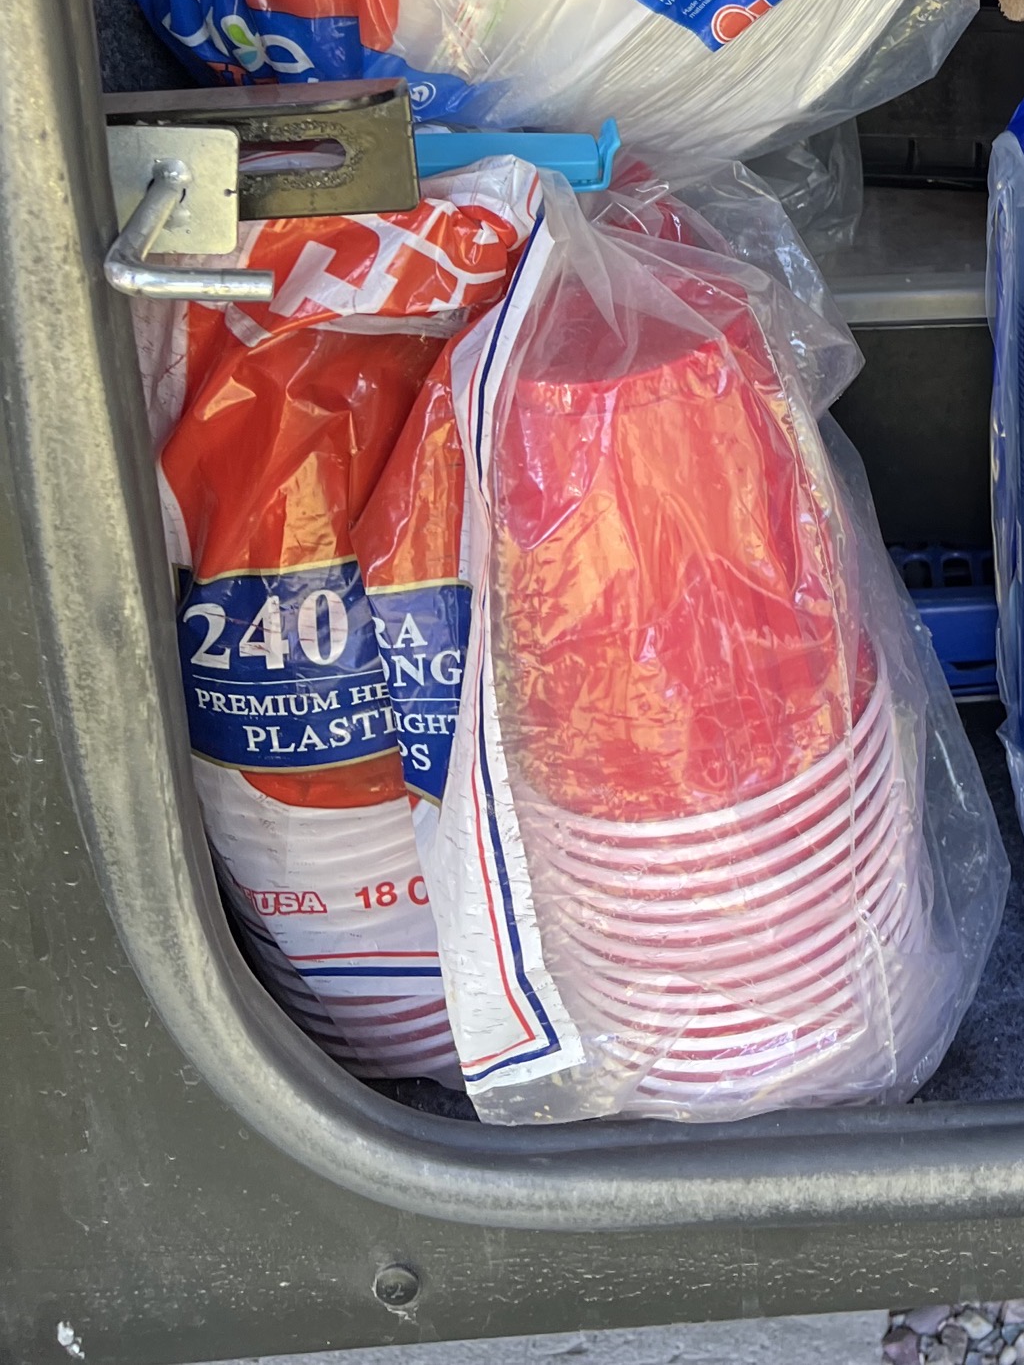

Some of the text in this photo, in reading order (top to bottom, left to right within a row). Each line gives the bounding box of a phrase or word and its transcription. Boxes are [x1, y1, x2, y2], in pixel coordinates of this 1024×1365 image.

[682, 1, 698, 16] Made
[183, 589, 348, 670] 240
[194, 687, 338, 716] PREMIUM
[251, 890, 328, 916] USA
[355, 881, 398, 909] 18
